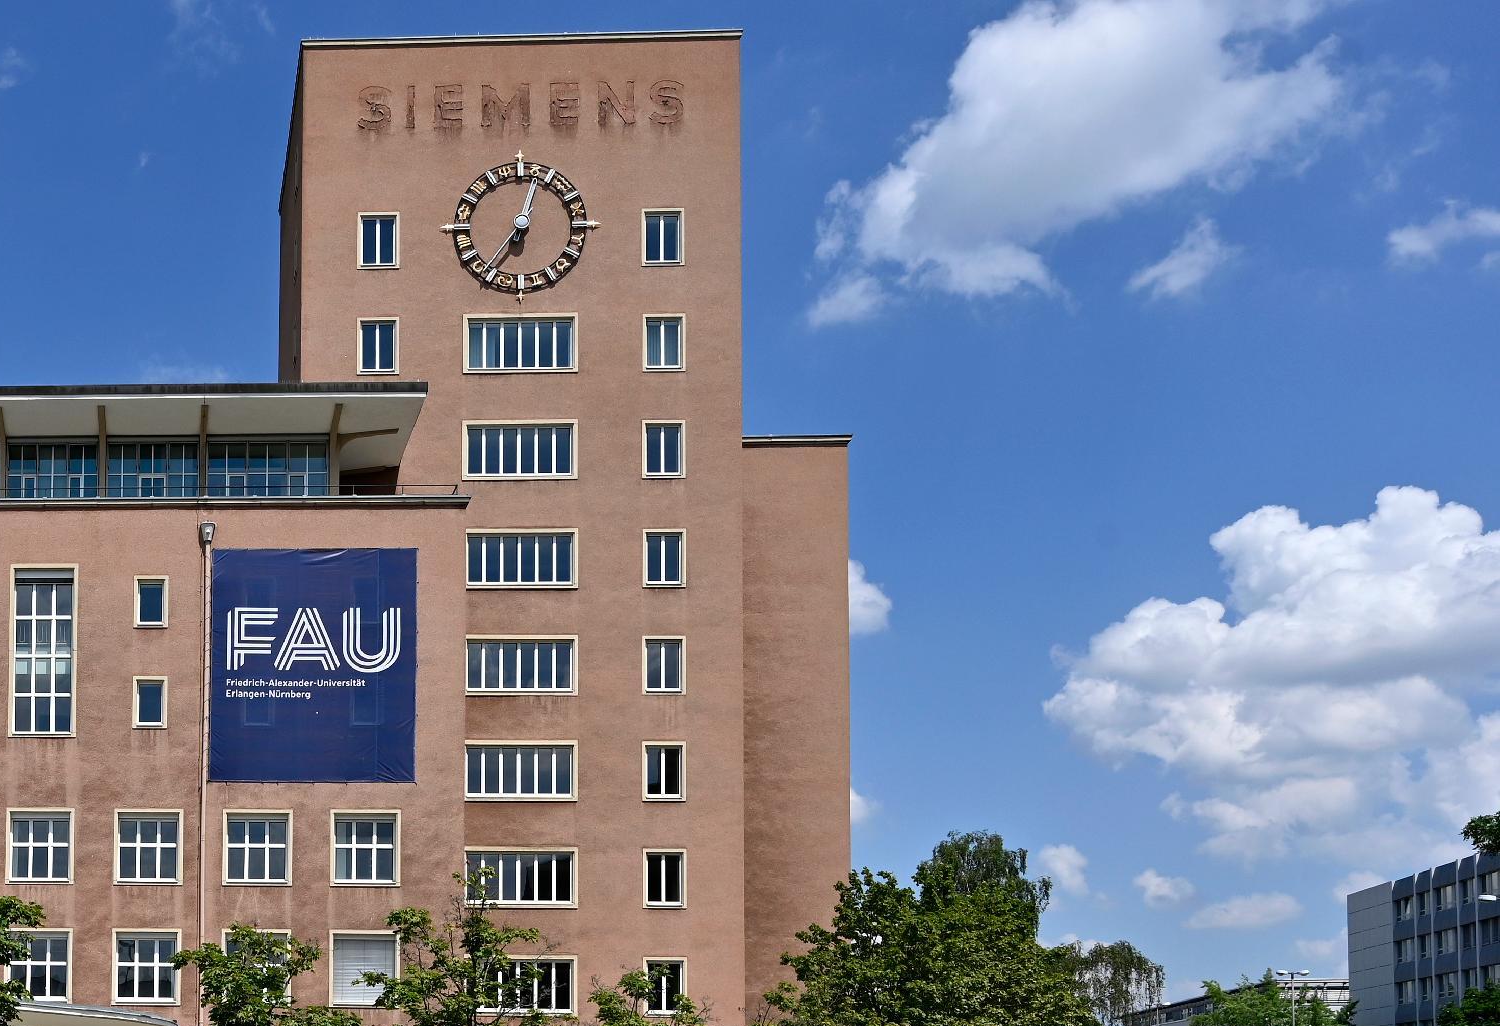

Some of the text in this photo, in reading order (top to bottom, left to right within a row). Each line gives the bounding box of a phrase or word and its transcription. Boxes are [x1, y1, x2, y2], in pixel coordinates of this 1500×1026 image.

[357, 79, 685, 131] SIEMENS
[226, 606, 402, 674] FAU
[225, 678, 366, 688] Friedrich-Alexander-Universität
[225, 689, 312, 700] Erlangen-Nürnberg
